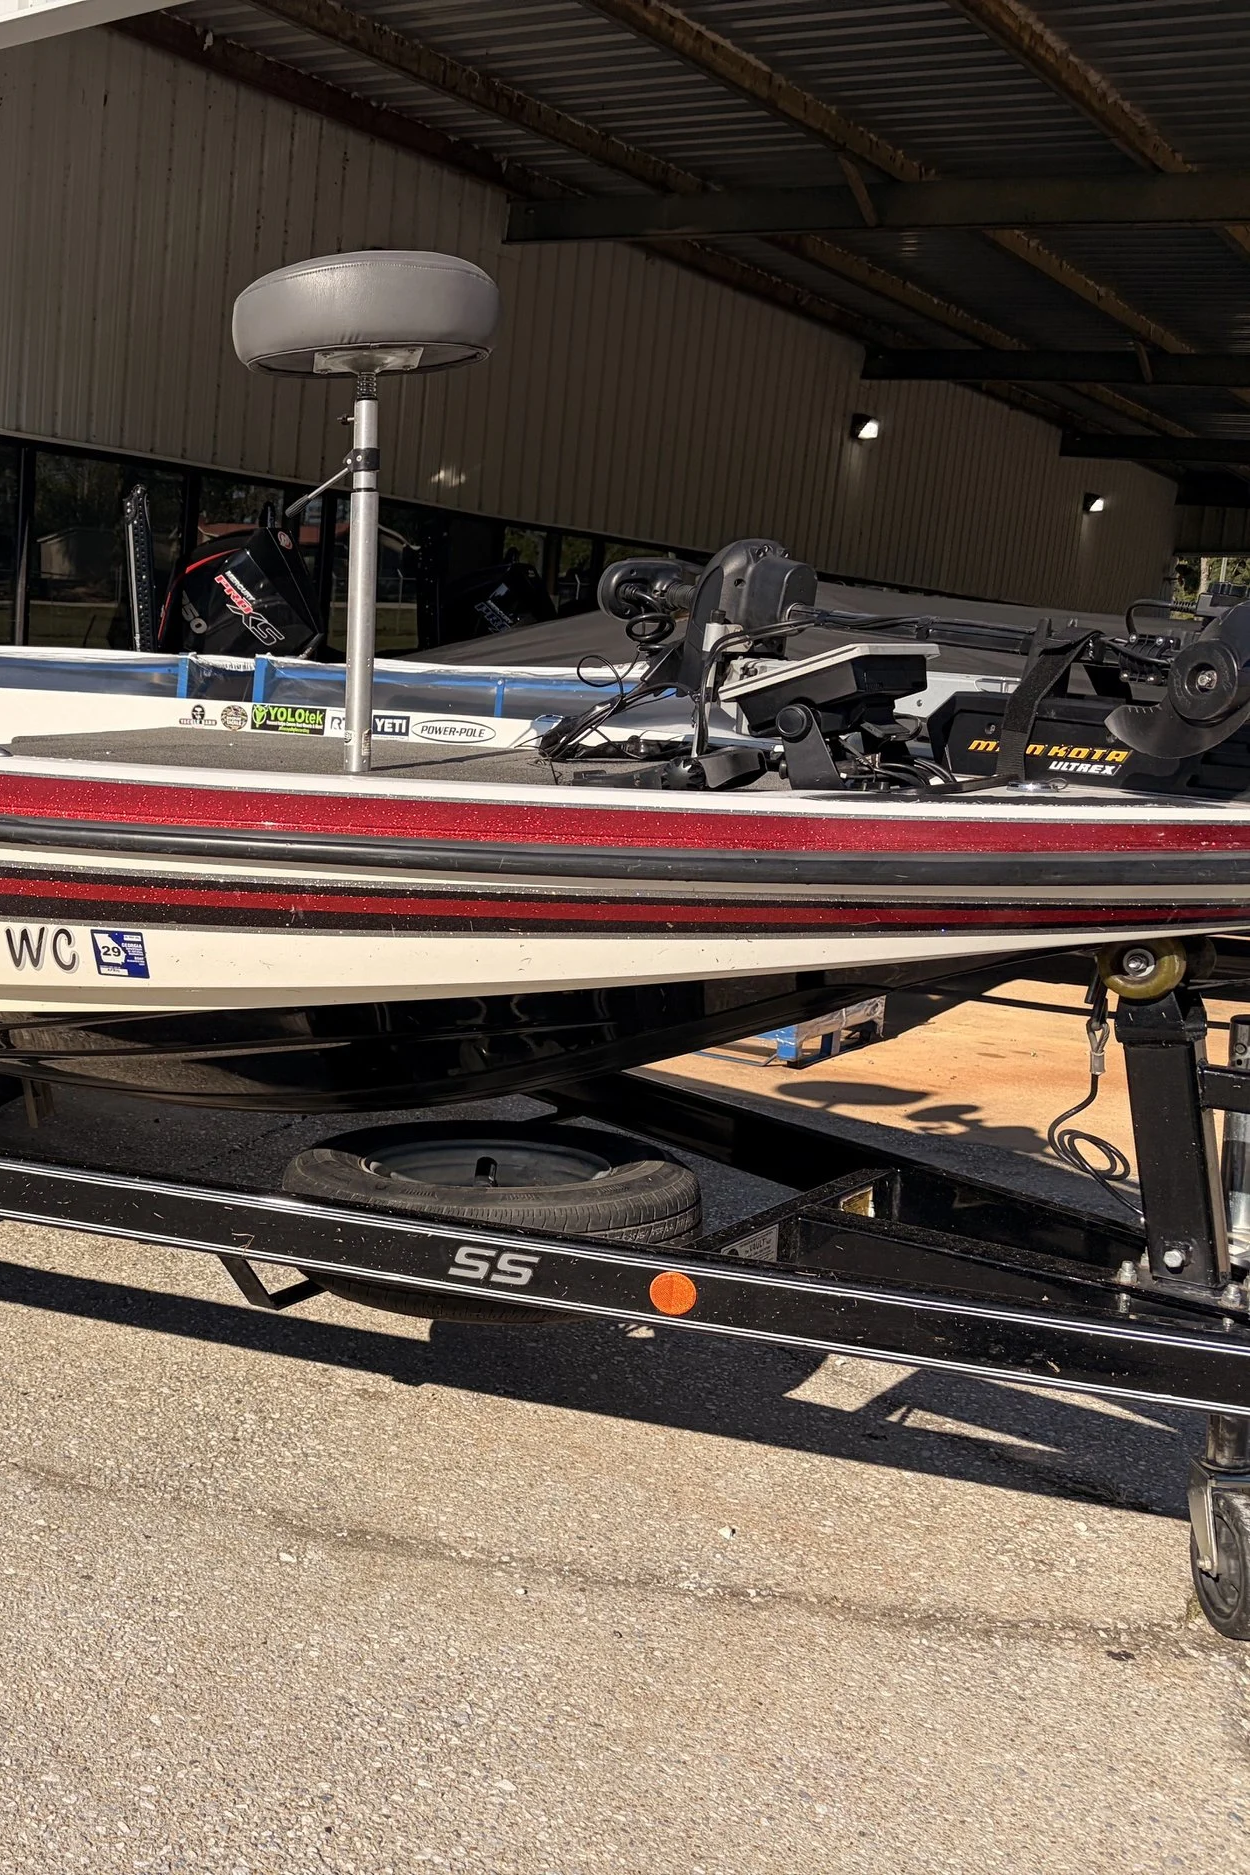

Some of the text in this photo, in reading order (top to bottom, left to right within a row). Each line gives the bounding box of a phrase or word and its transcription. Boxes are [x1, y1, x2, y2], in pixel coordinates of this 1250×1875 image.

[225, 571, 256, 604] MERCURY
[214, 574, 285, 646] PRO XS
[270, 707, 324, 725] YOLOtek
[375, 718, 407, 733] YETI
[968, 739, 1129, 763] MN KOTA
[1049, 761, 1116, 776] ULTREX
[5, 926, 80, 973] WC
[101, 945, 121, 957] 29
[448, 1246, 542, 1285] SS
